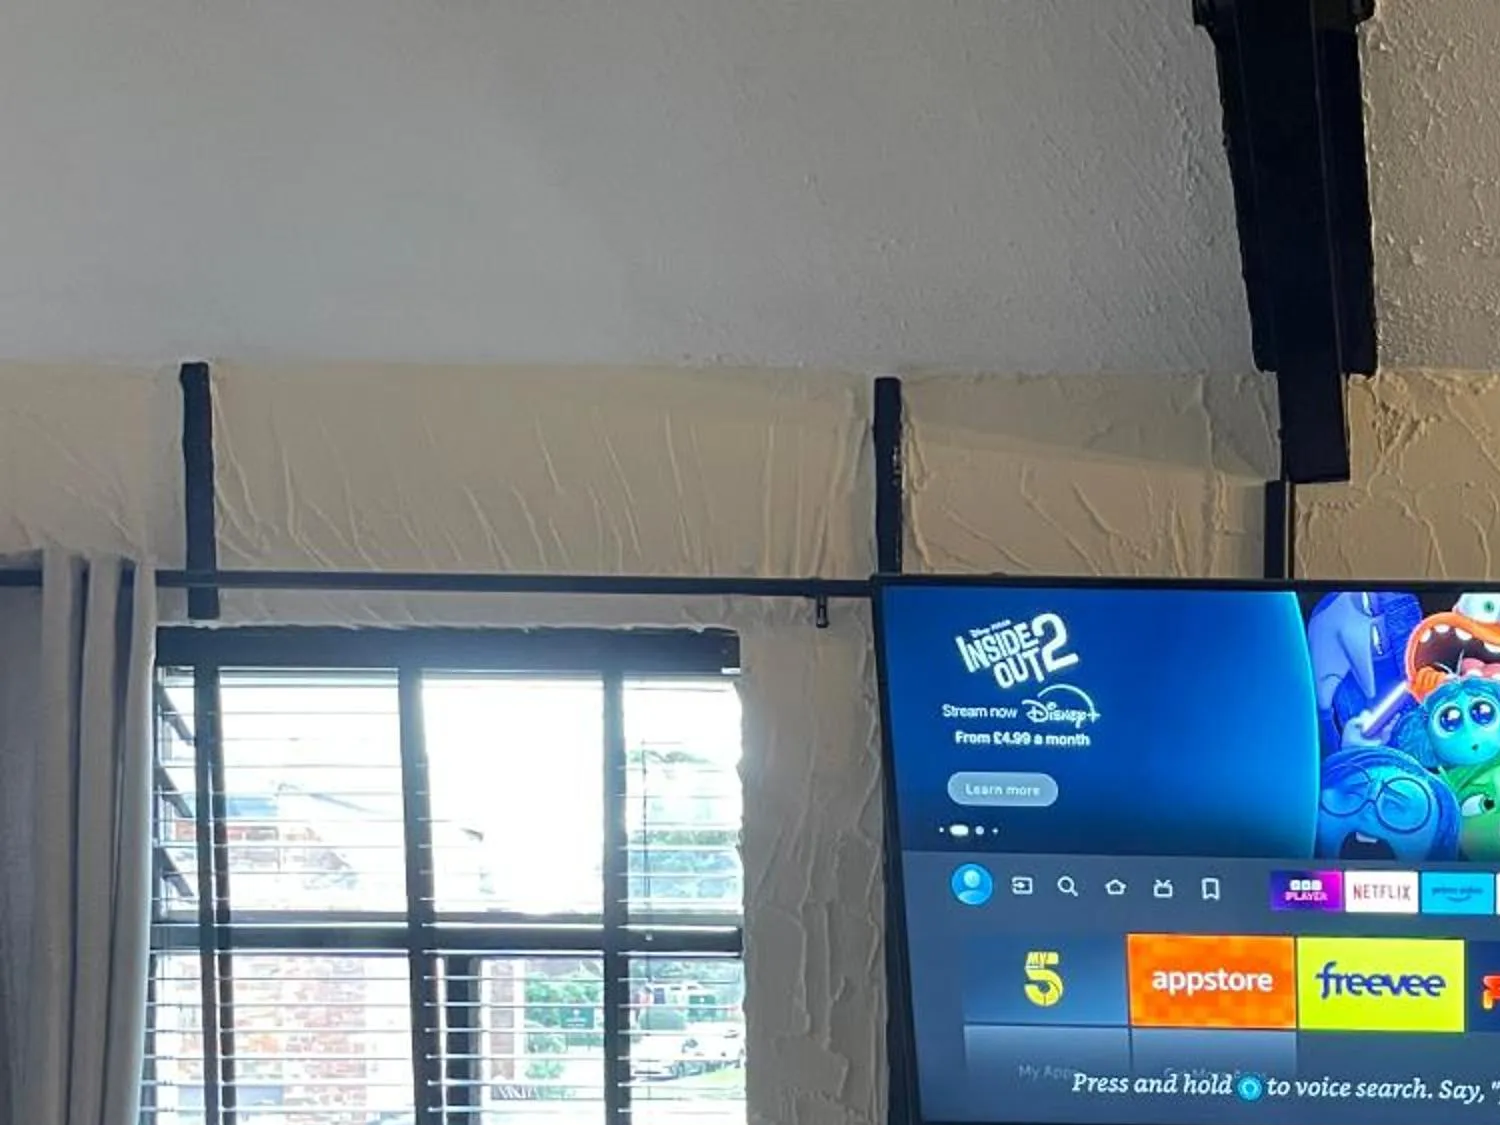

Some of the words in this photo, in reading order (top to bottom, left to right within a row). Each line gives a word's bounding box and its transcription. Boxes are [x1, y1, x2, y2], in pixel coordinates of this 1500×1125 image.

[955, 622, 1040, 673] INSIDE
[993, 647, 1045, 688] OUT
[1032, 613, 1079, 673] 2
[942, 703, 988, 719] Stream
[990, 707, 1018, 719] now
[955, 730, 991, 745] From
[993, 731, 1032, 746] £4.99
[1034, 734, 1043, 746] a
[1045, 733, 1092, 747] month
[965, 782, 1003, 796] Learn
[1006, 785, 1041, 797] more
[1353, 884, 1411, 901] NETFLIX
[1152, 967, 1274, 996] appstore
[1315, 960, 1446, 999] freevee
[1072, 1072, 1129, 1093] Press
[1134, 1074, 1177, 1094] and
[1183, 1074, 1232, 1095] hold
[1267, 1077, 1291, 1096] to
[1296, 1076, 1351, 1098] voice
[1355, 1077, 1433, 1100] search.
[1438, 1079, 1485, 1104] Say,
